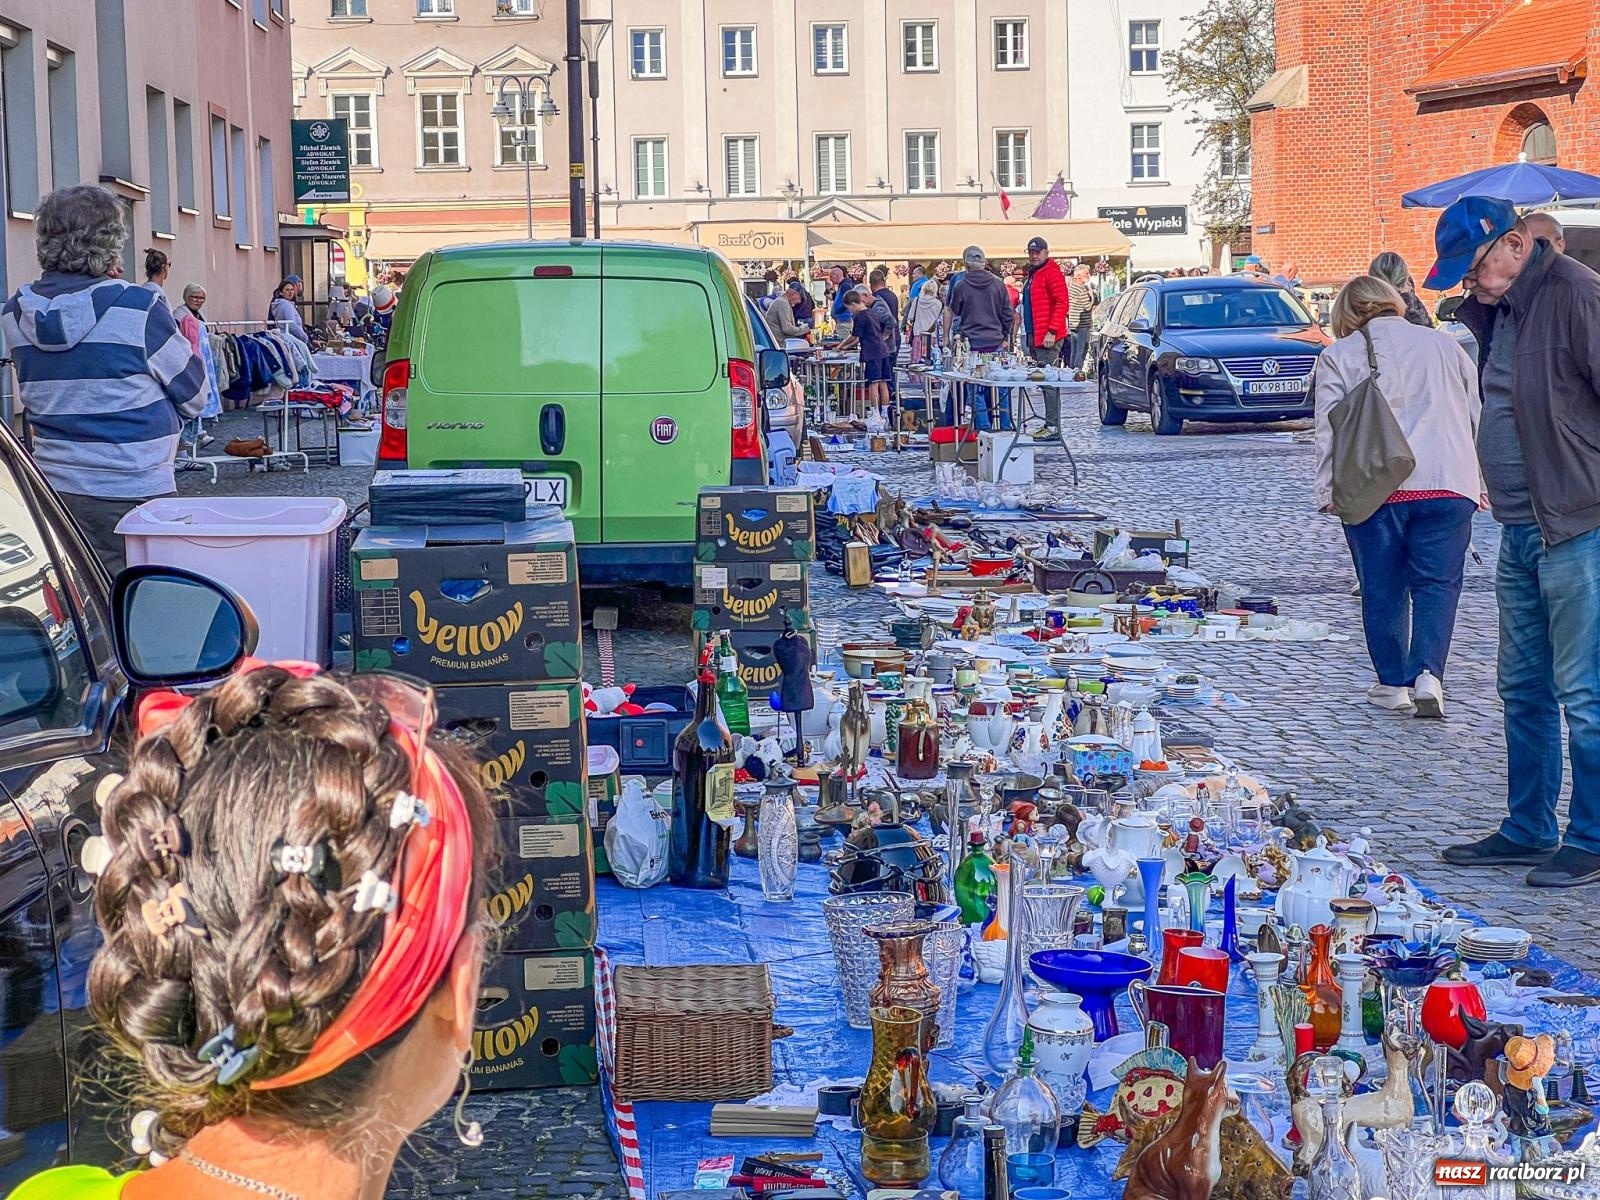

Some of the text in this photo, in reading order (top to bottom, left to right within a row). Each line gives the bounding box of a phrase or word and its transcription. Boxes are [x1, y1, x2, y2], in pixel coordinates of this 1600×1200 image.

[1134, 216, 1182, 231] Wypieki
[1252, 382, 1299, 392] OK 98130
[656, 423, 672, 438] FIAT
[430, 653, 509, 670] PREMIUM BANANAS
[486, 1058, 524, 1074] BANANAS
